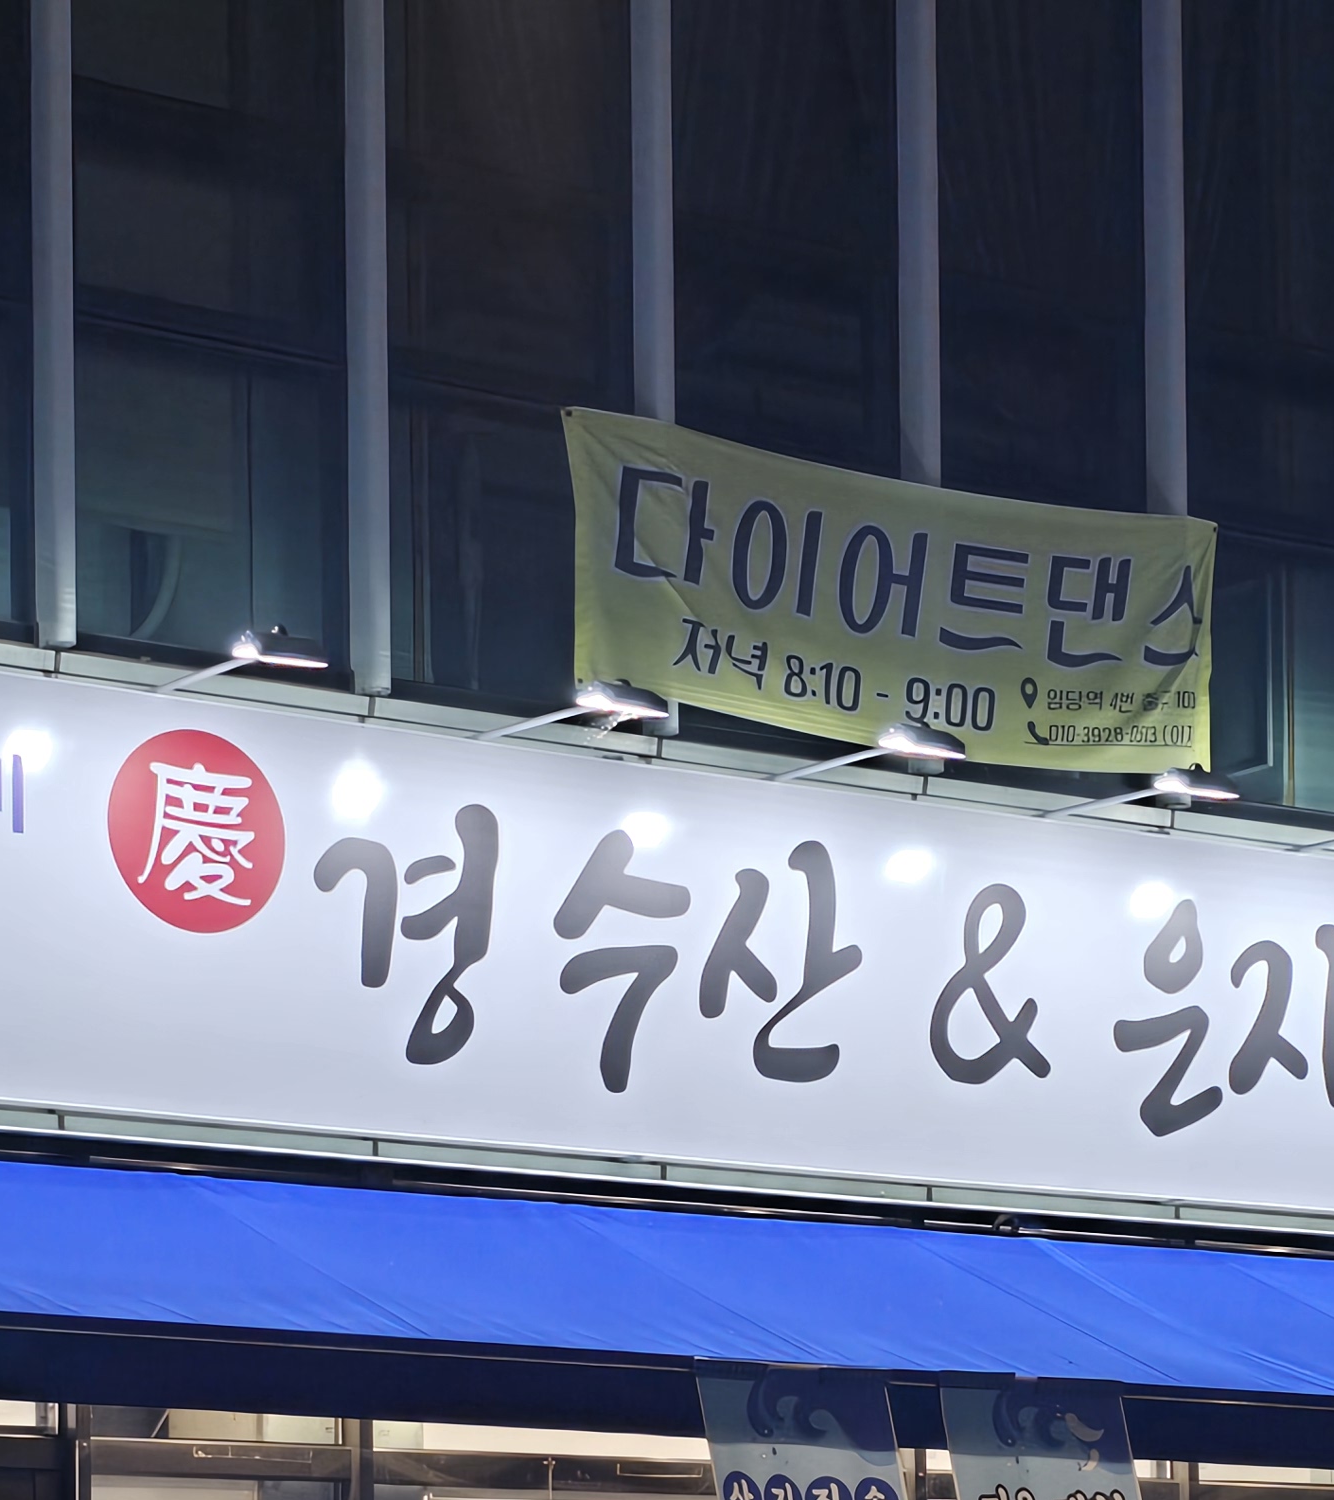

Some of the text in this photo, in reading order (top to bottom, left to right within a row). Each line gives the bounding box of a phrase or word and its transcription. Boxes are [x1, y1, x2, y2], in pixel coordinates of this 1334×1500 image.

[614, 465, 1201, 668] 다이어트댄스
[672, 617, 768, 690] 저녁
[782, 653, 862, 713] 8:10
[905, 677, 997, 733] 9:00
[137, 760, 258, 909] 慶
[929, 882, 1052, 1085] &
